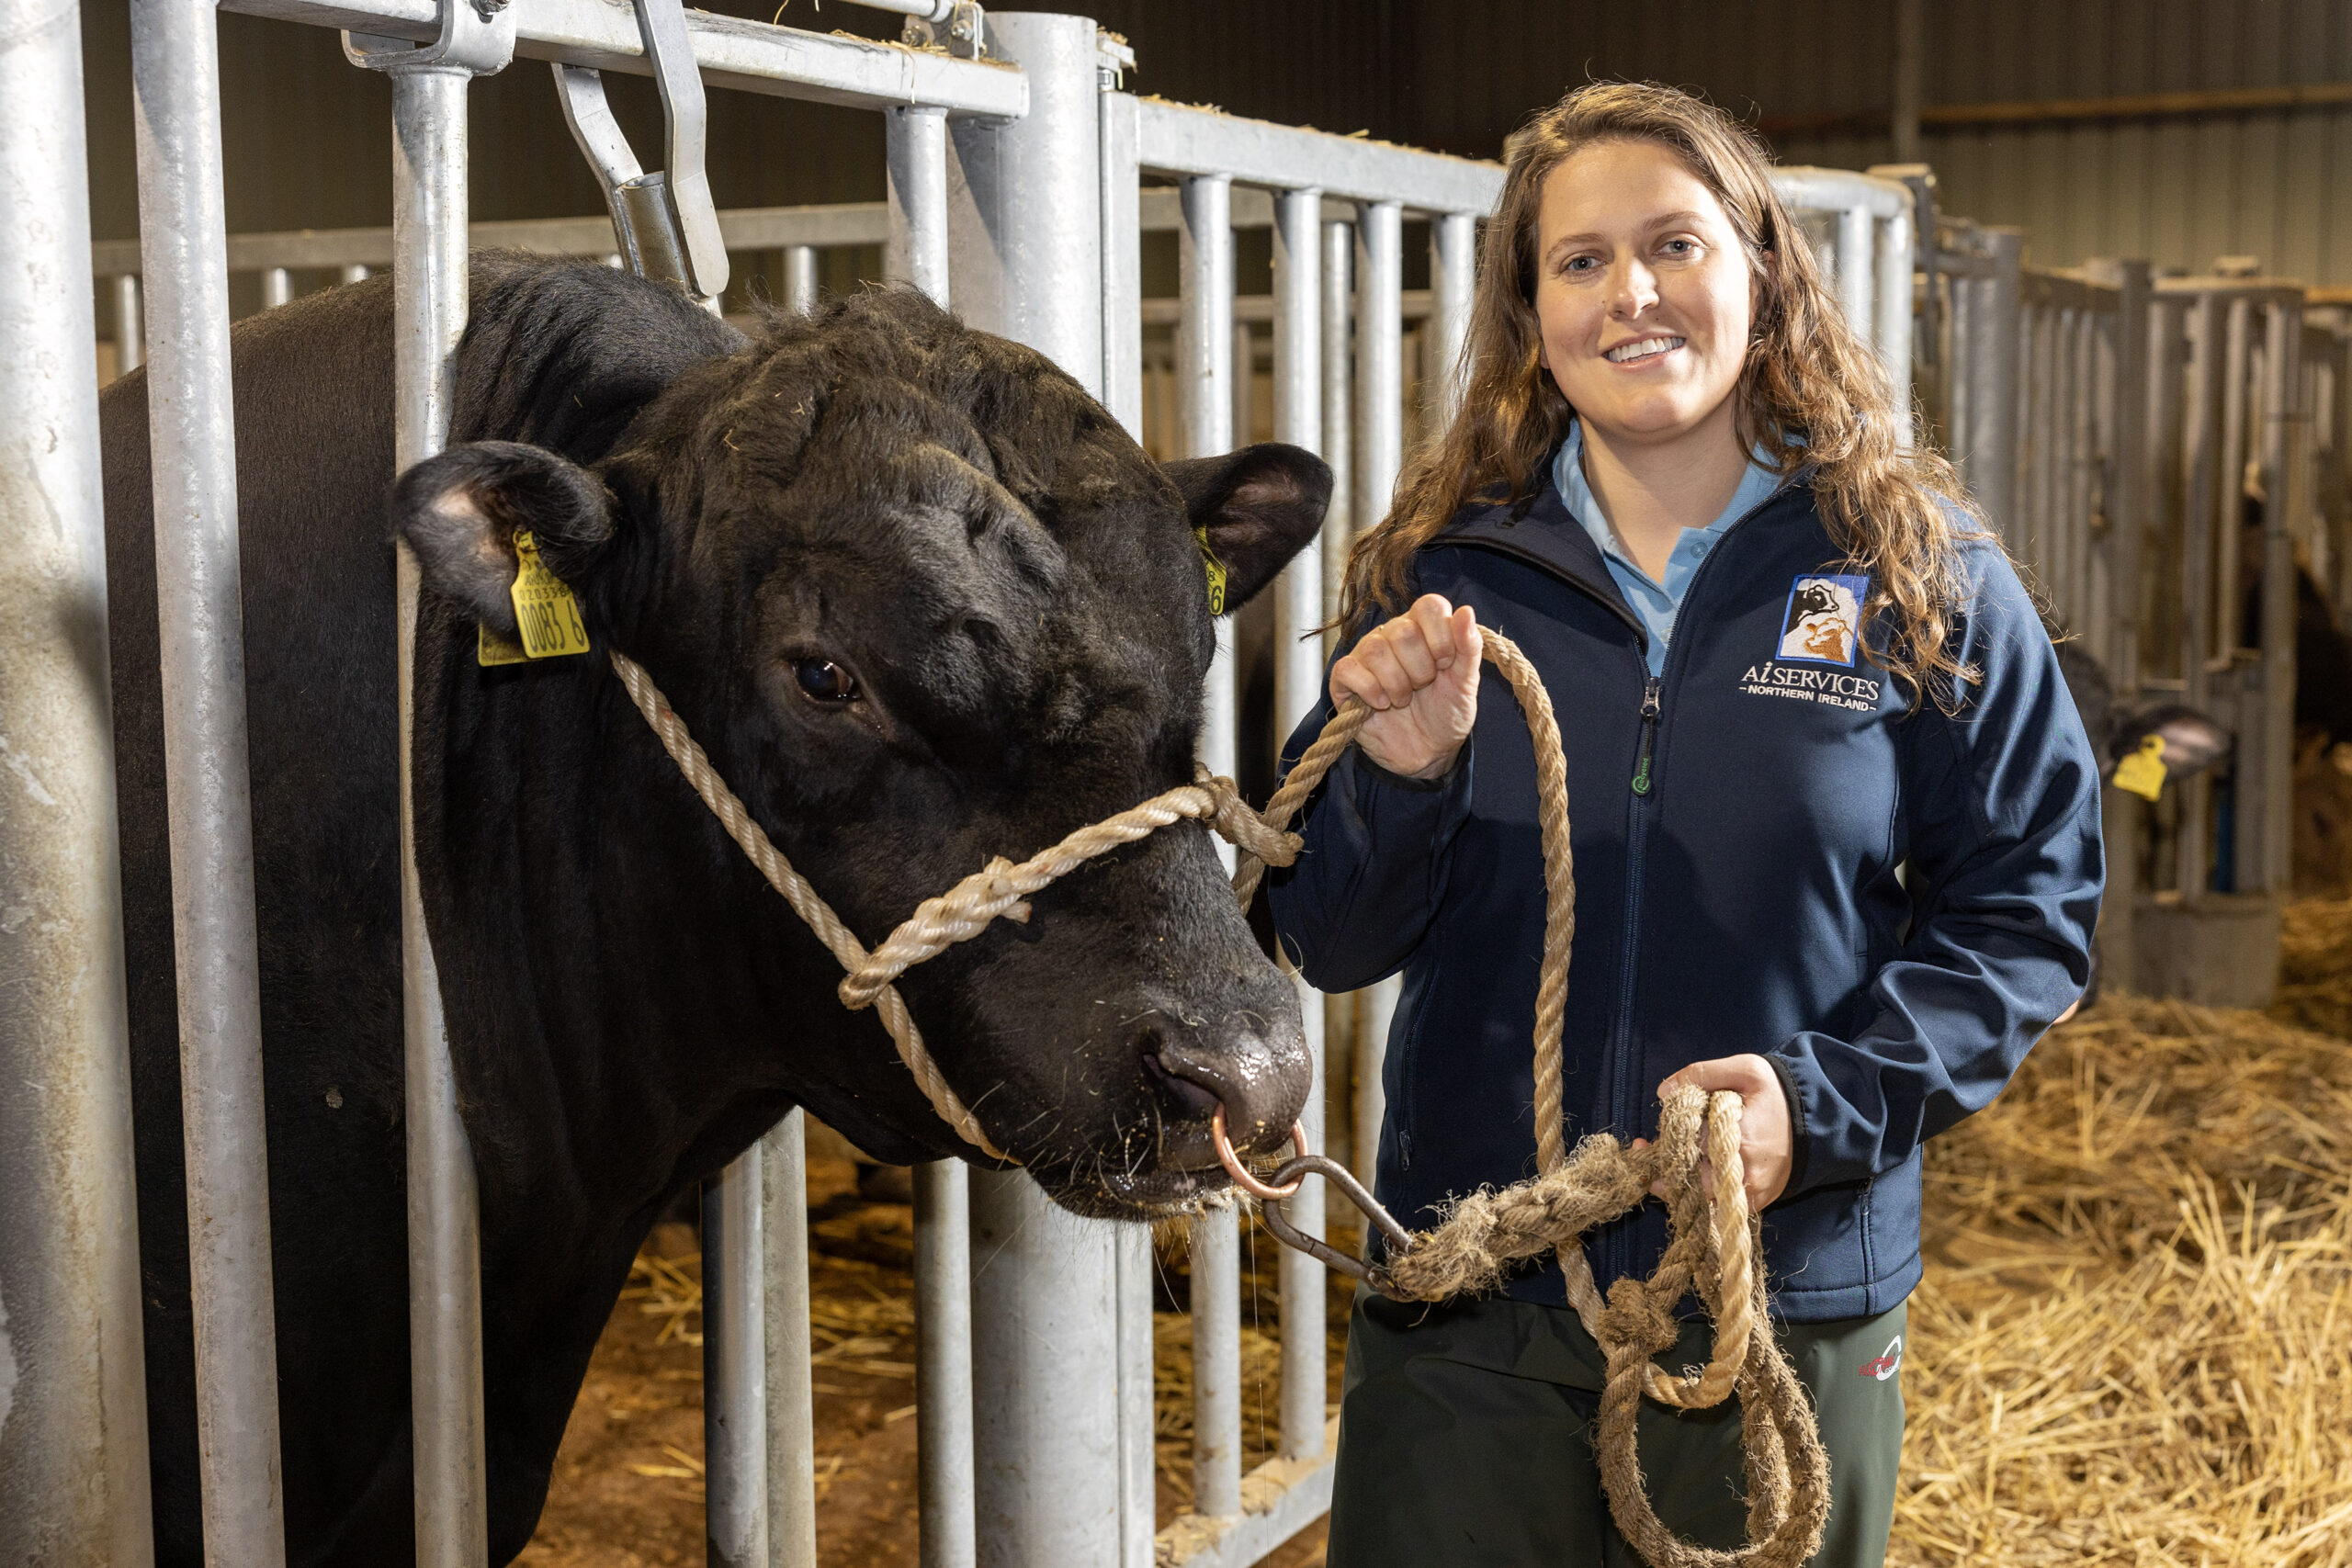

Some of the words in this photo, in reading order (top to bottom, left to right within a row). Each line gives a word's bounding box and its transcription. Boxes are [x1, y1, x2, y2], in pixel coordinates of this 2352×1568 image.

[518, 586, 568, 601] 020338
[1211, 585, 1223, 614] 6
[521, 601, 566, 653] 0083
[567, 599, 585, 648] 6
[1747, 684, 1815, 701] NORTHERN
[1817, 693, 1869, 712] IRELAND
[1772, 668, 1880, 701] SERVICES
